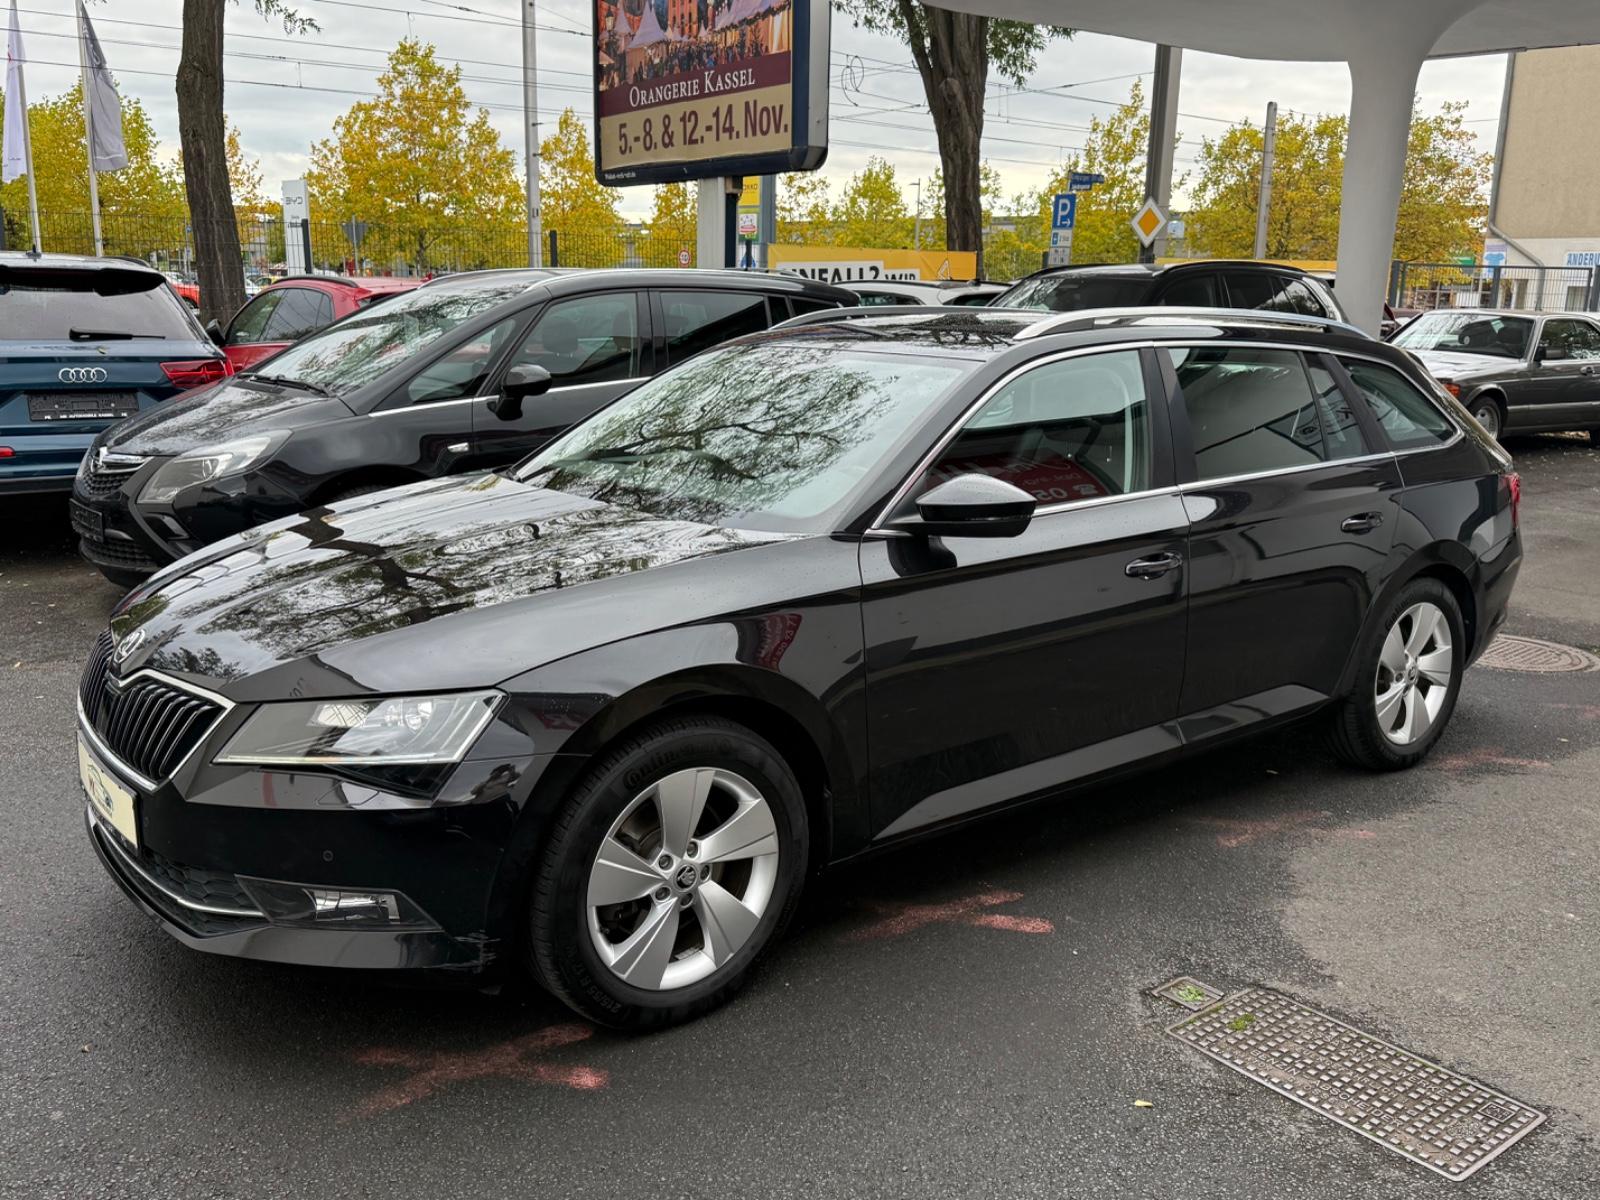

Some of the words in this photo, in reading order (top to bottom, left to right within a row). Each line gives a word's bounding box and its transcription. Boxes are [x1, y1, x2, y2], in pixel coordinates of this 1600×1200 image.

[629, 78, 700, 108] ORANGERIE
[704, 68, 755, 94] KASSEL
[661, 114, 675, 149] &
[744, 99, 789, 138] Nov.
[1056, 198, 1071, 226] P
[1248, 1048, 1303, 1076] BENZIN
